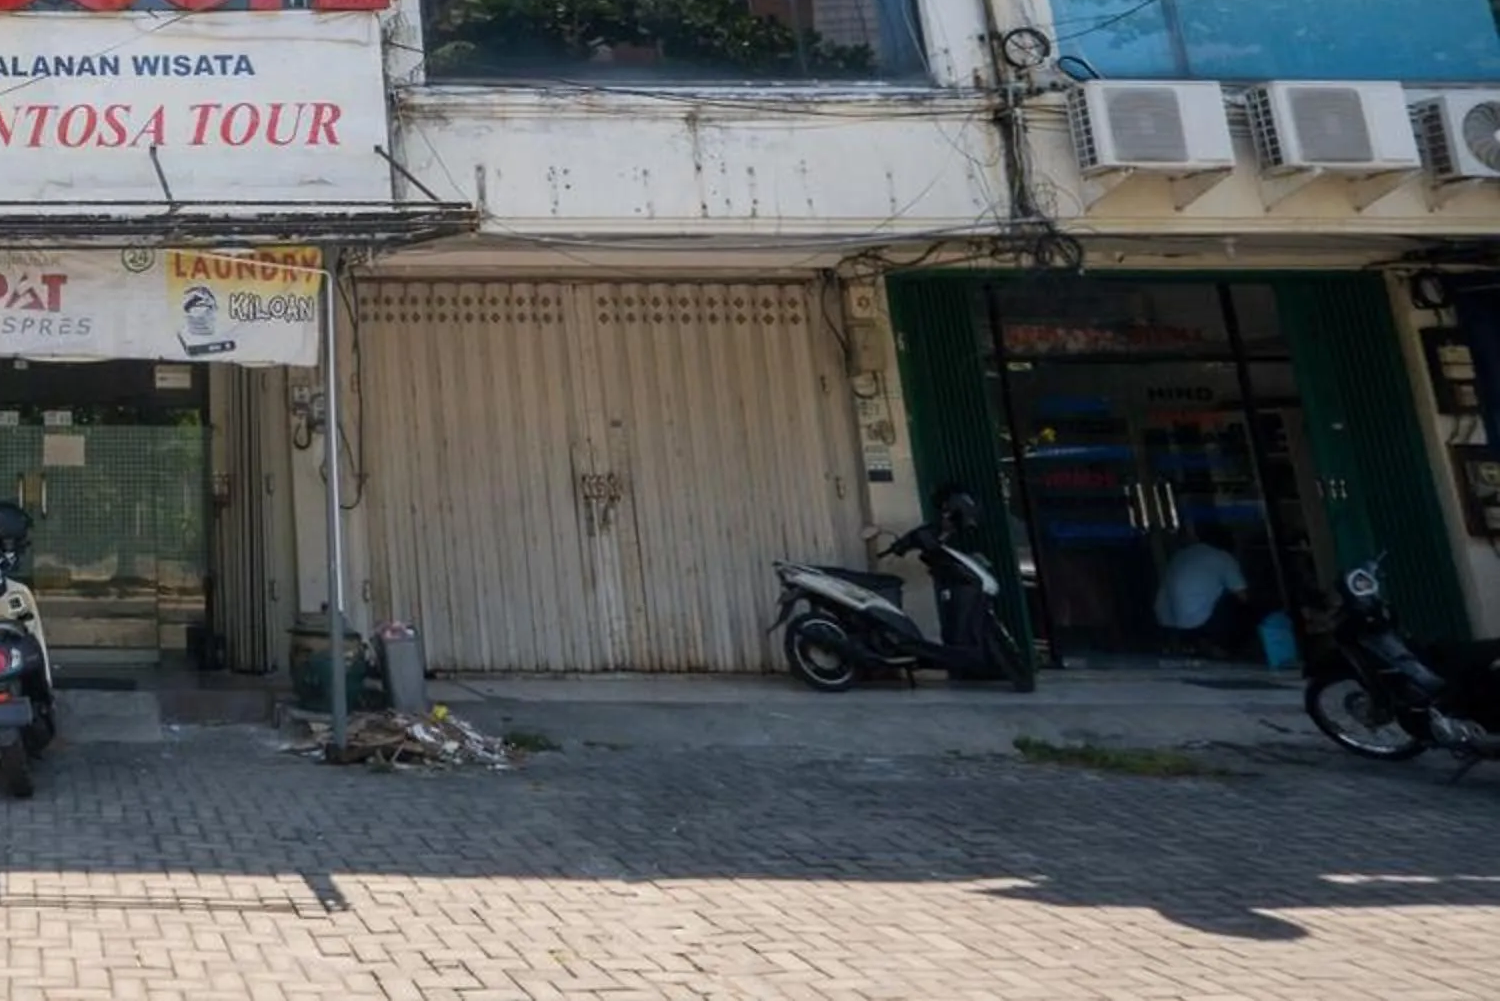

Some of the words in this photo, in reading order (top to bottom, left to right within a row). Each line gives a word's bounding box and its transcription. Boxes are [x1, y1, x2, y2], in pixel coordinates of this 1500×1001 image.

[131, 53, 256, 77] WISATA
[189, 101, 343, 147] TOUR
[174, 251, 319, 284] LAUNDRY
